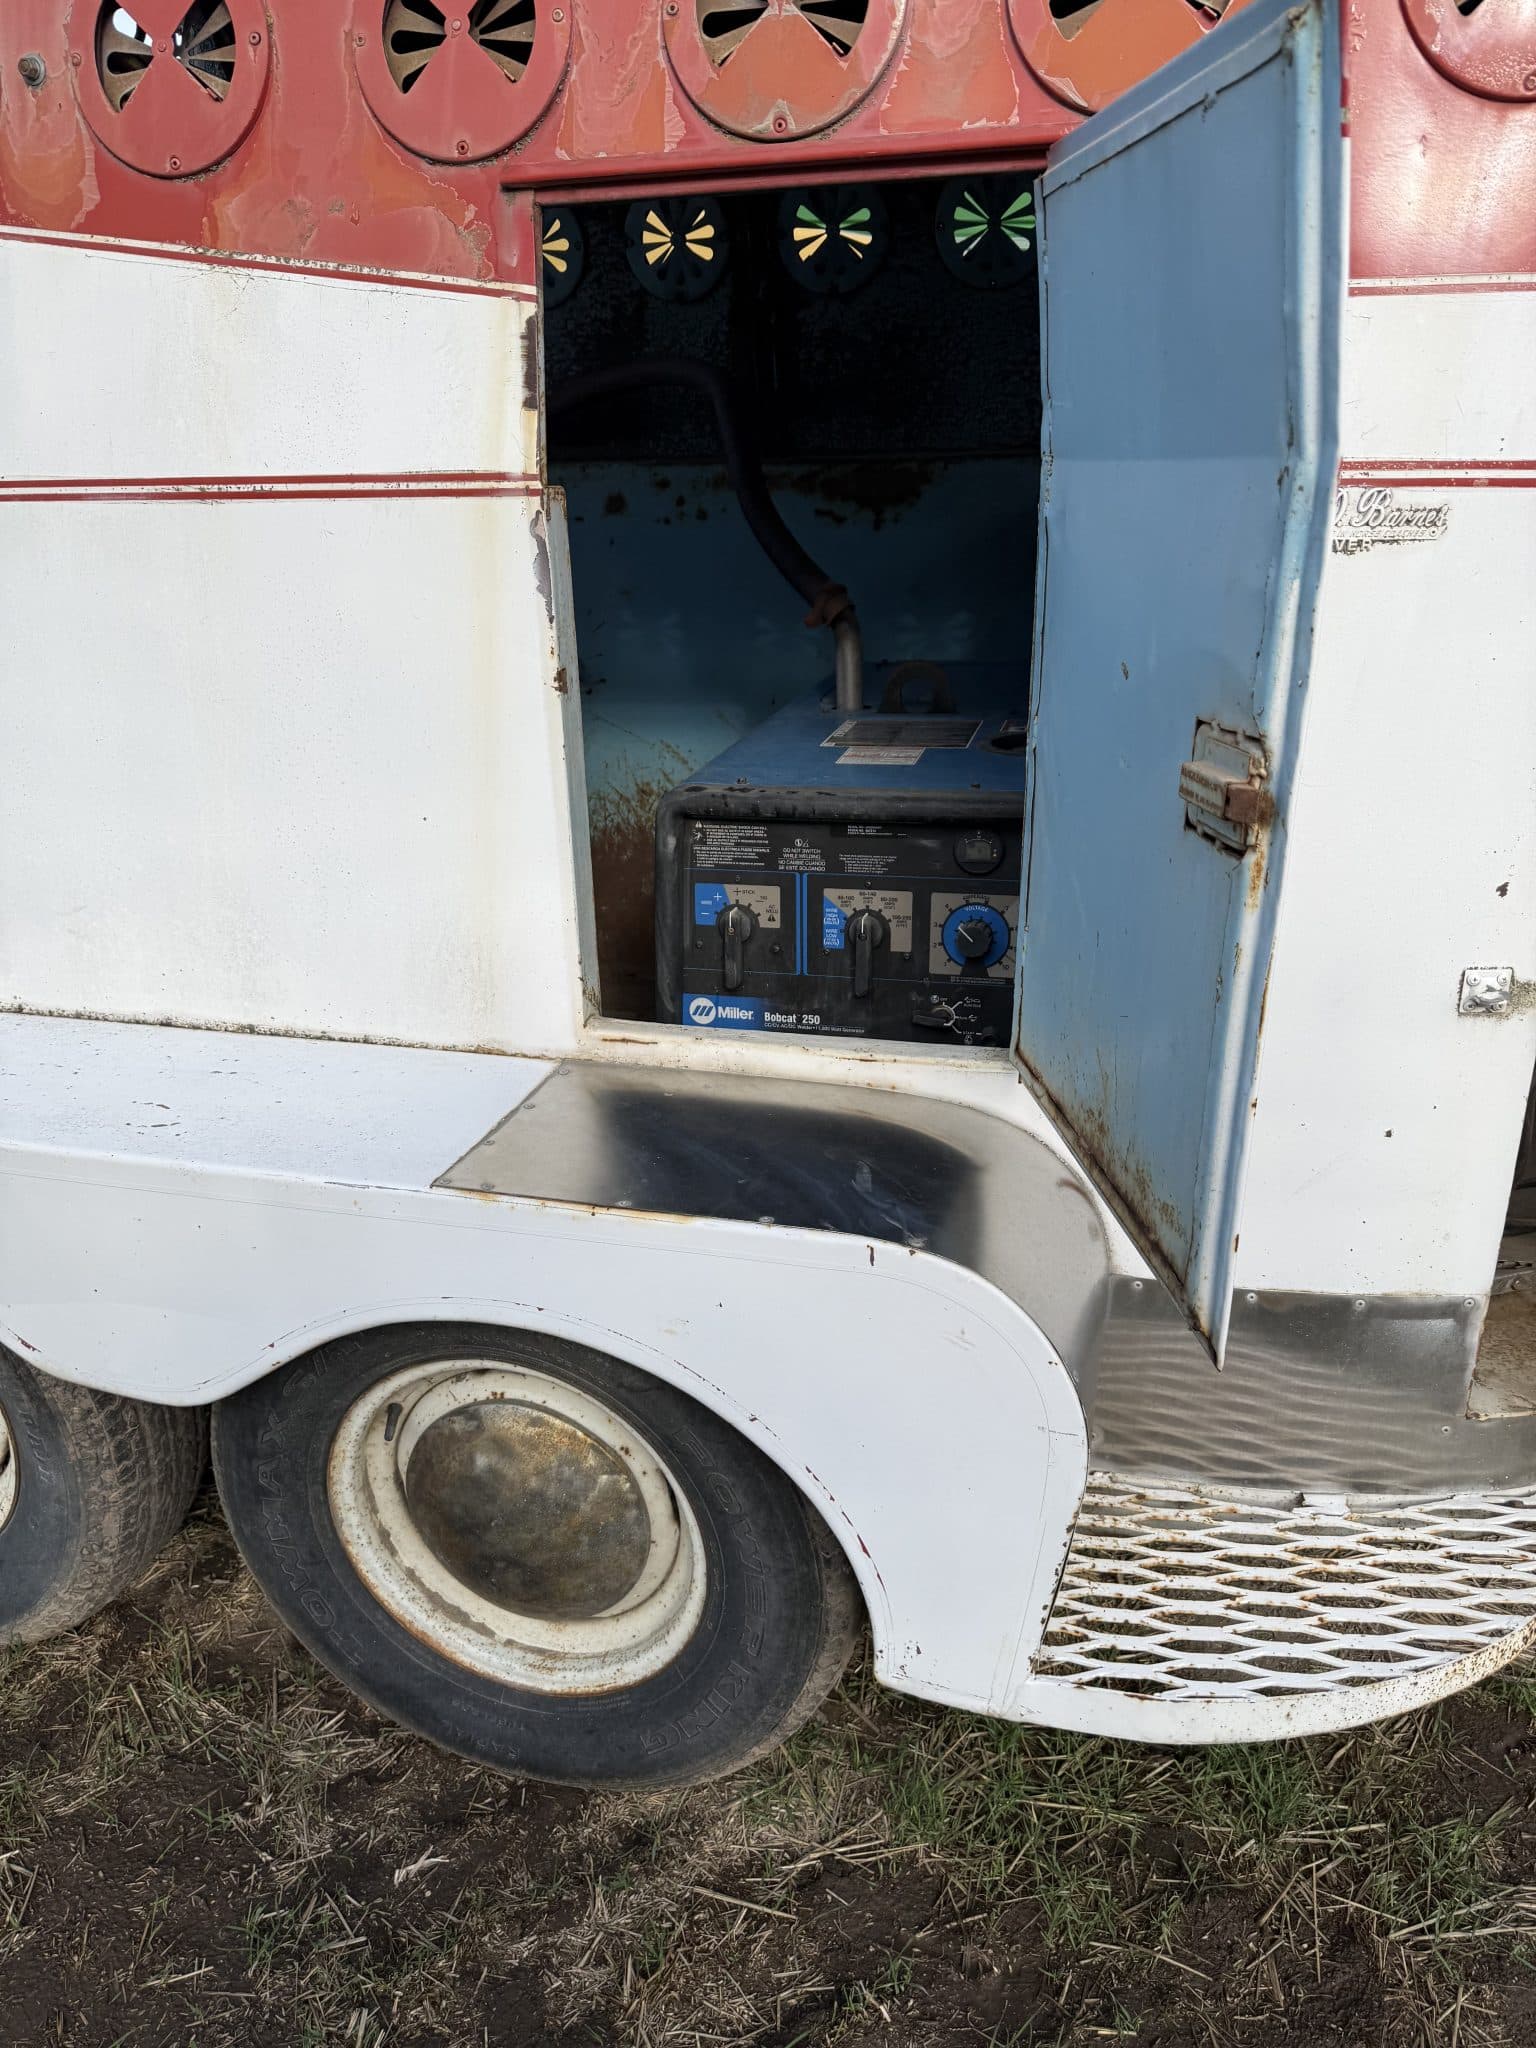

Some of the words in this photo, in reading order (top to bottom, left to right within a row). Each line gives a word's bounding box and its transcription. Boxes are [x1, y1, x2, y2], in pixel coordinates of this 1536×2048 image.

[1350, 487, 1449, 529] Barnes
[718, 1006, 753, 1021] Miller
[764, 1012, 796, 1023] Bobcat
[802, 1014, 820, 1025] 250
